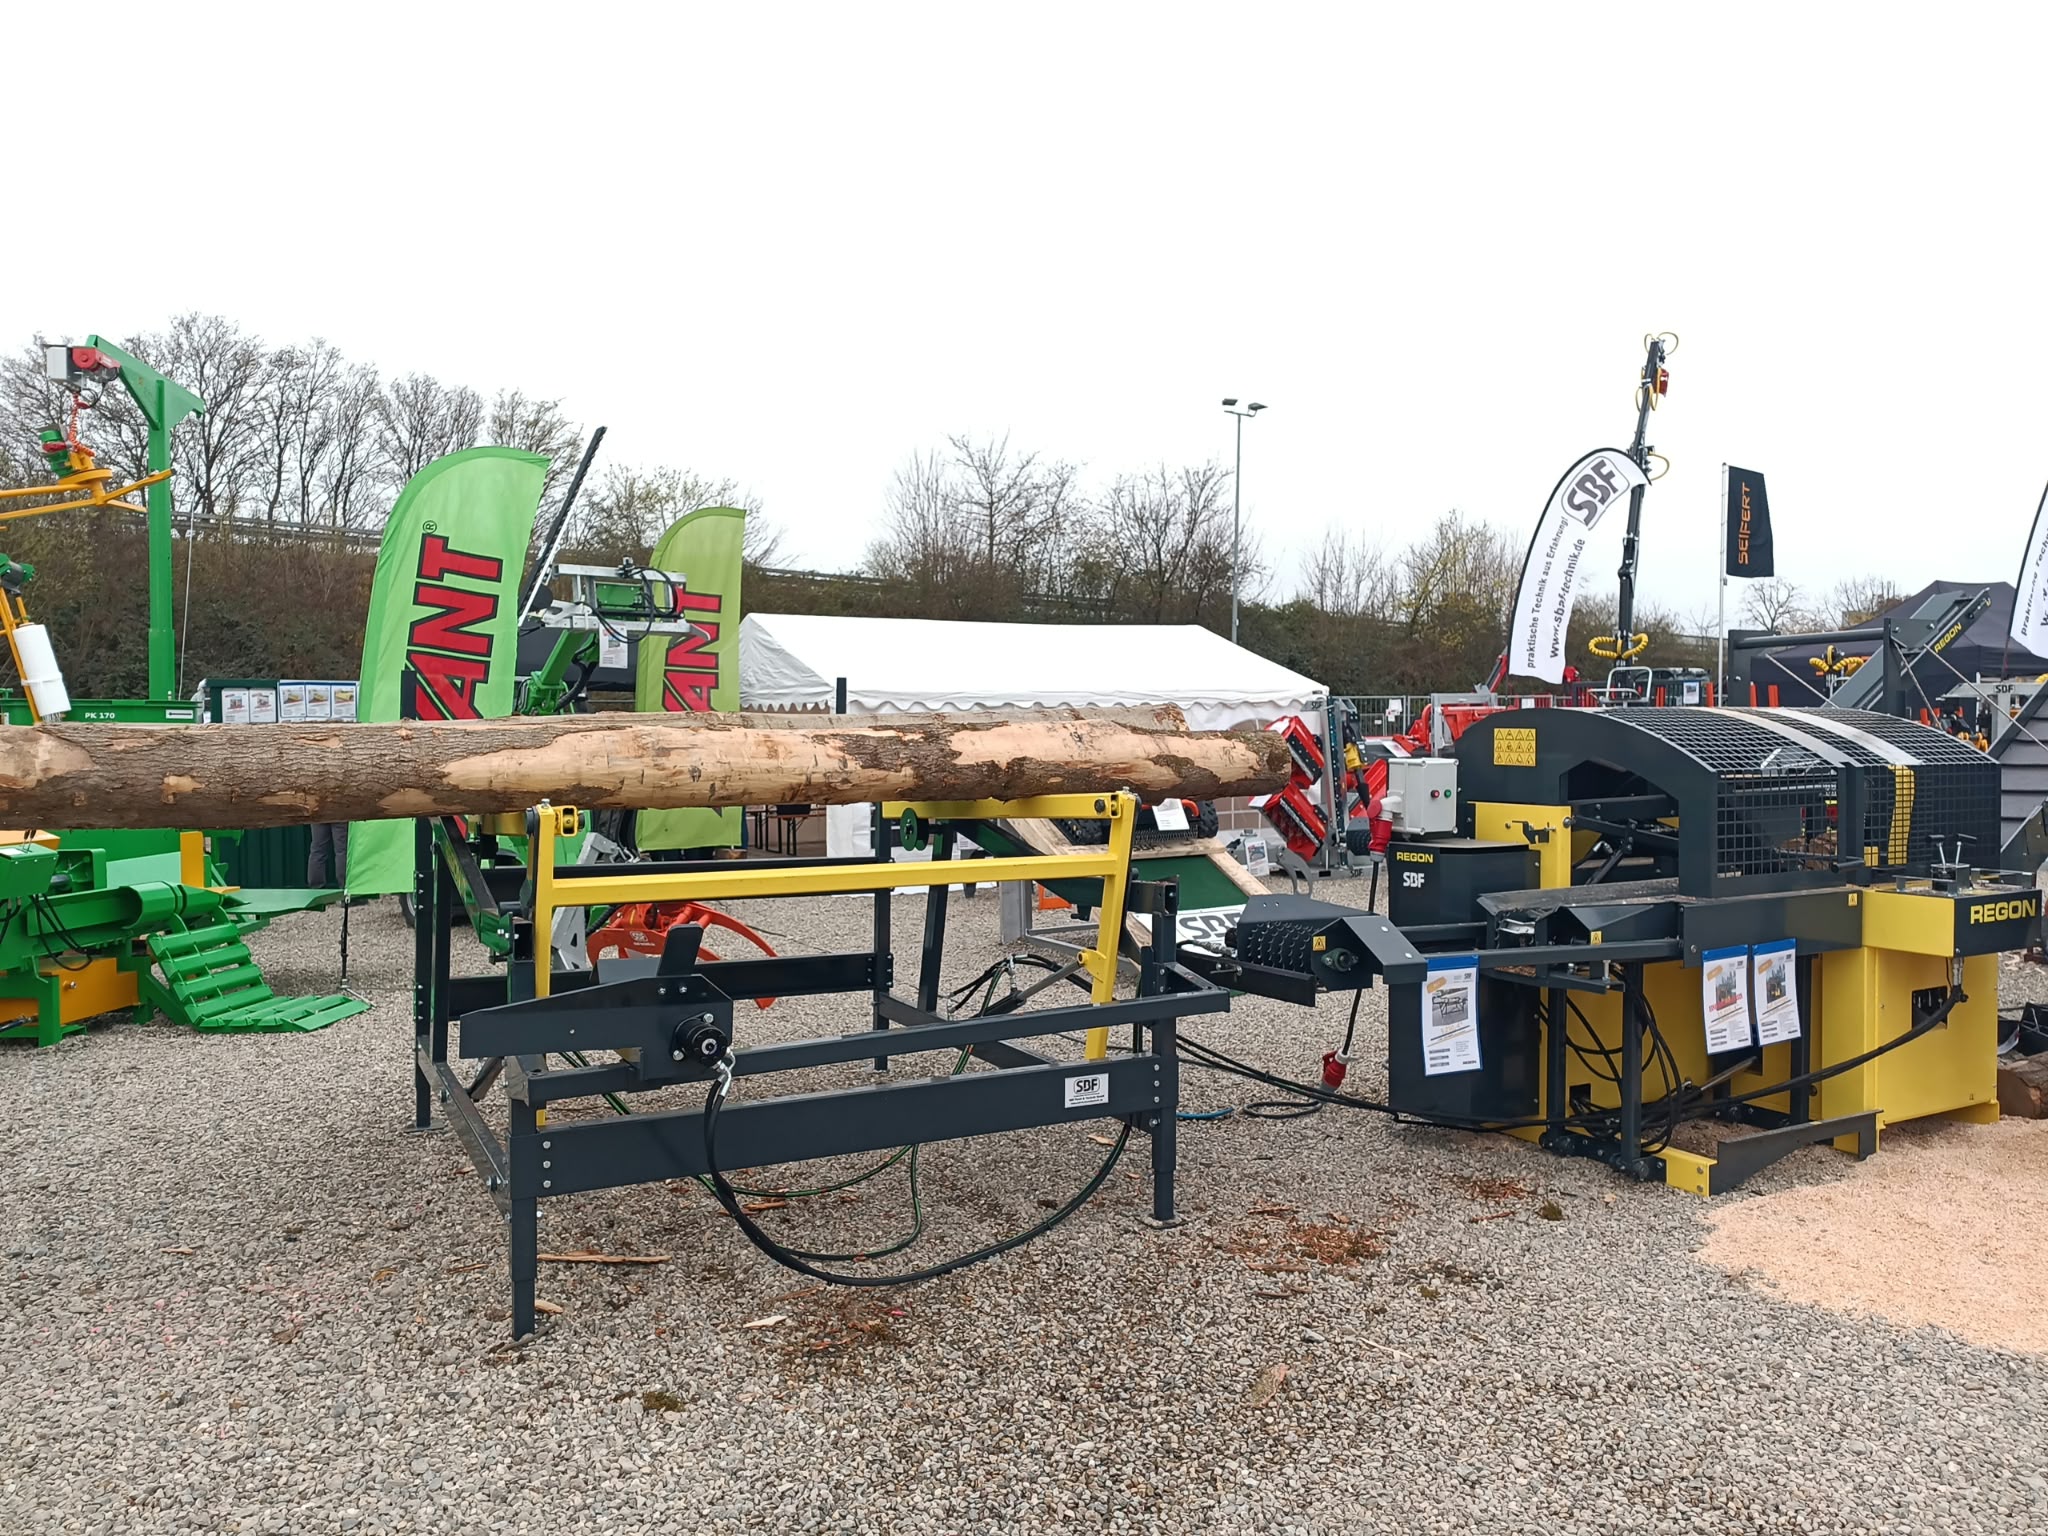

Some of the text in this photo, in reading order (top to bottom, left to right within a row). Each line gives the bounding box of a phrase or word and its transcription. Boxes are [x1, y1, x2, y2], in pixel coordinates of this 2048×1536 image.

[1567, 459, 1619, 527] SBF
[1738, 481, 1751, 565] SEIFERT
[1527, 516, 1569, 669] praktische Technik aus Erfahrung!
[1396, 851, 1434, 863] REGON
[1402, 871, 1425, 888] SBF
[1970, 898, 2036, 925] REGON
[1076, 1079, 1098, 1092] SBF
